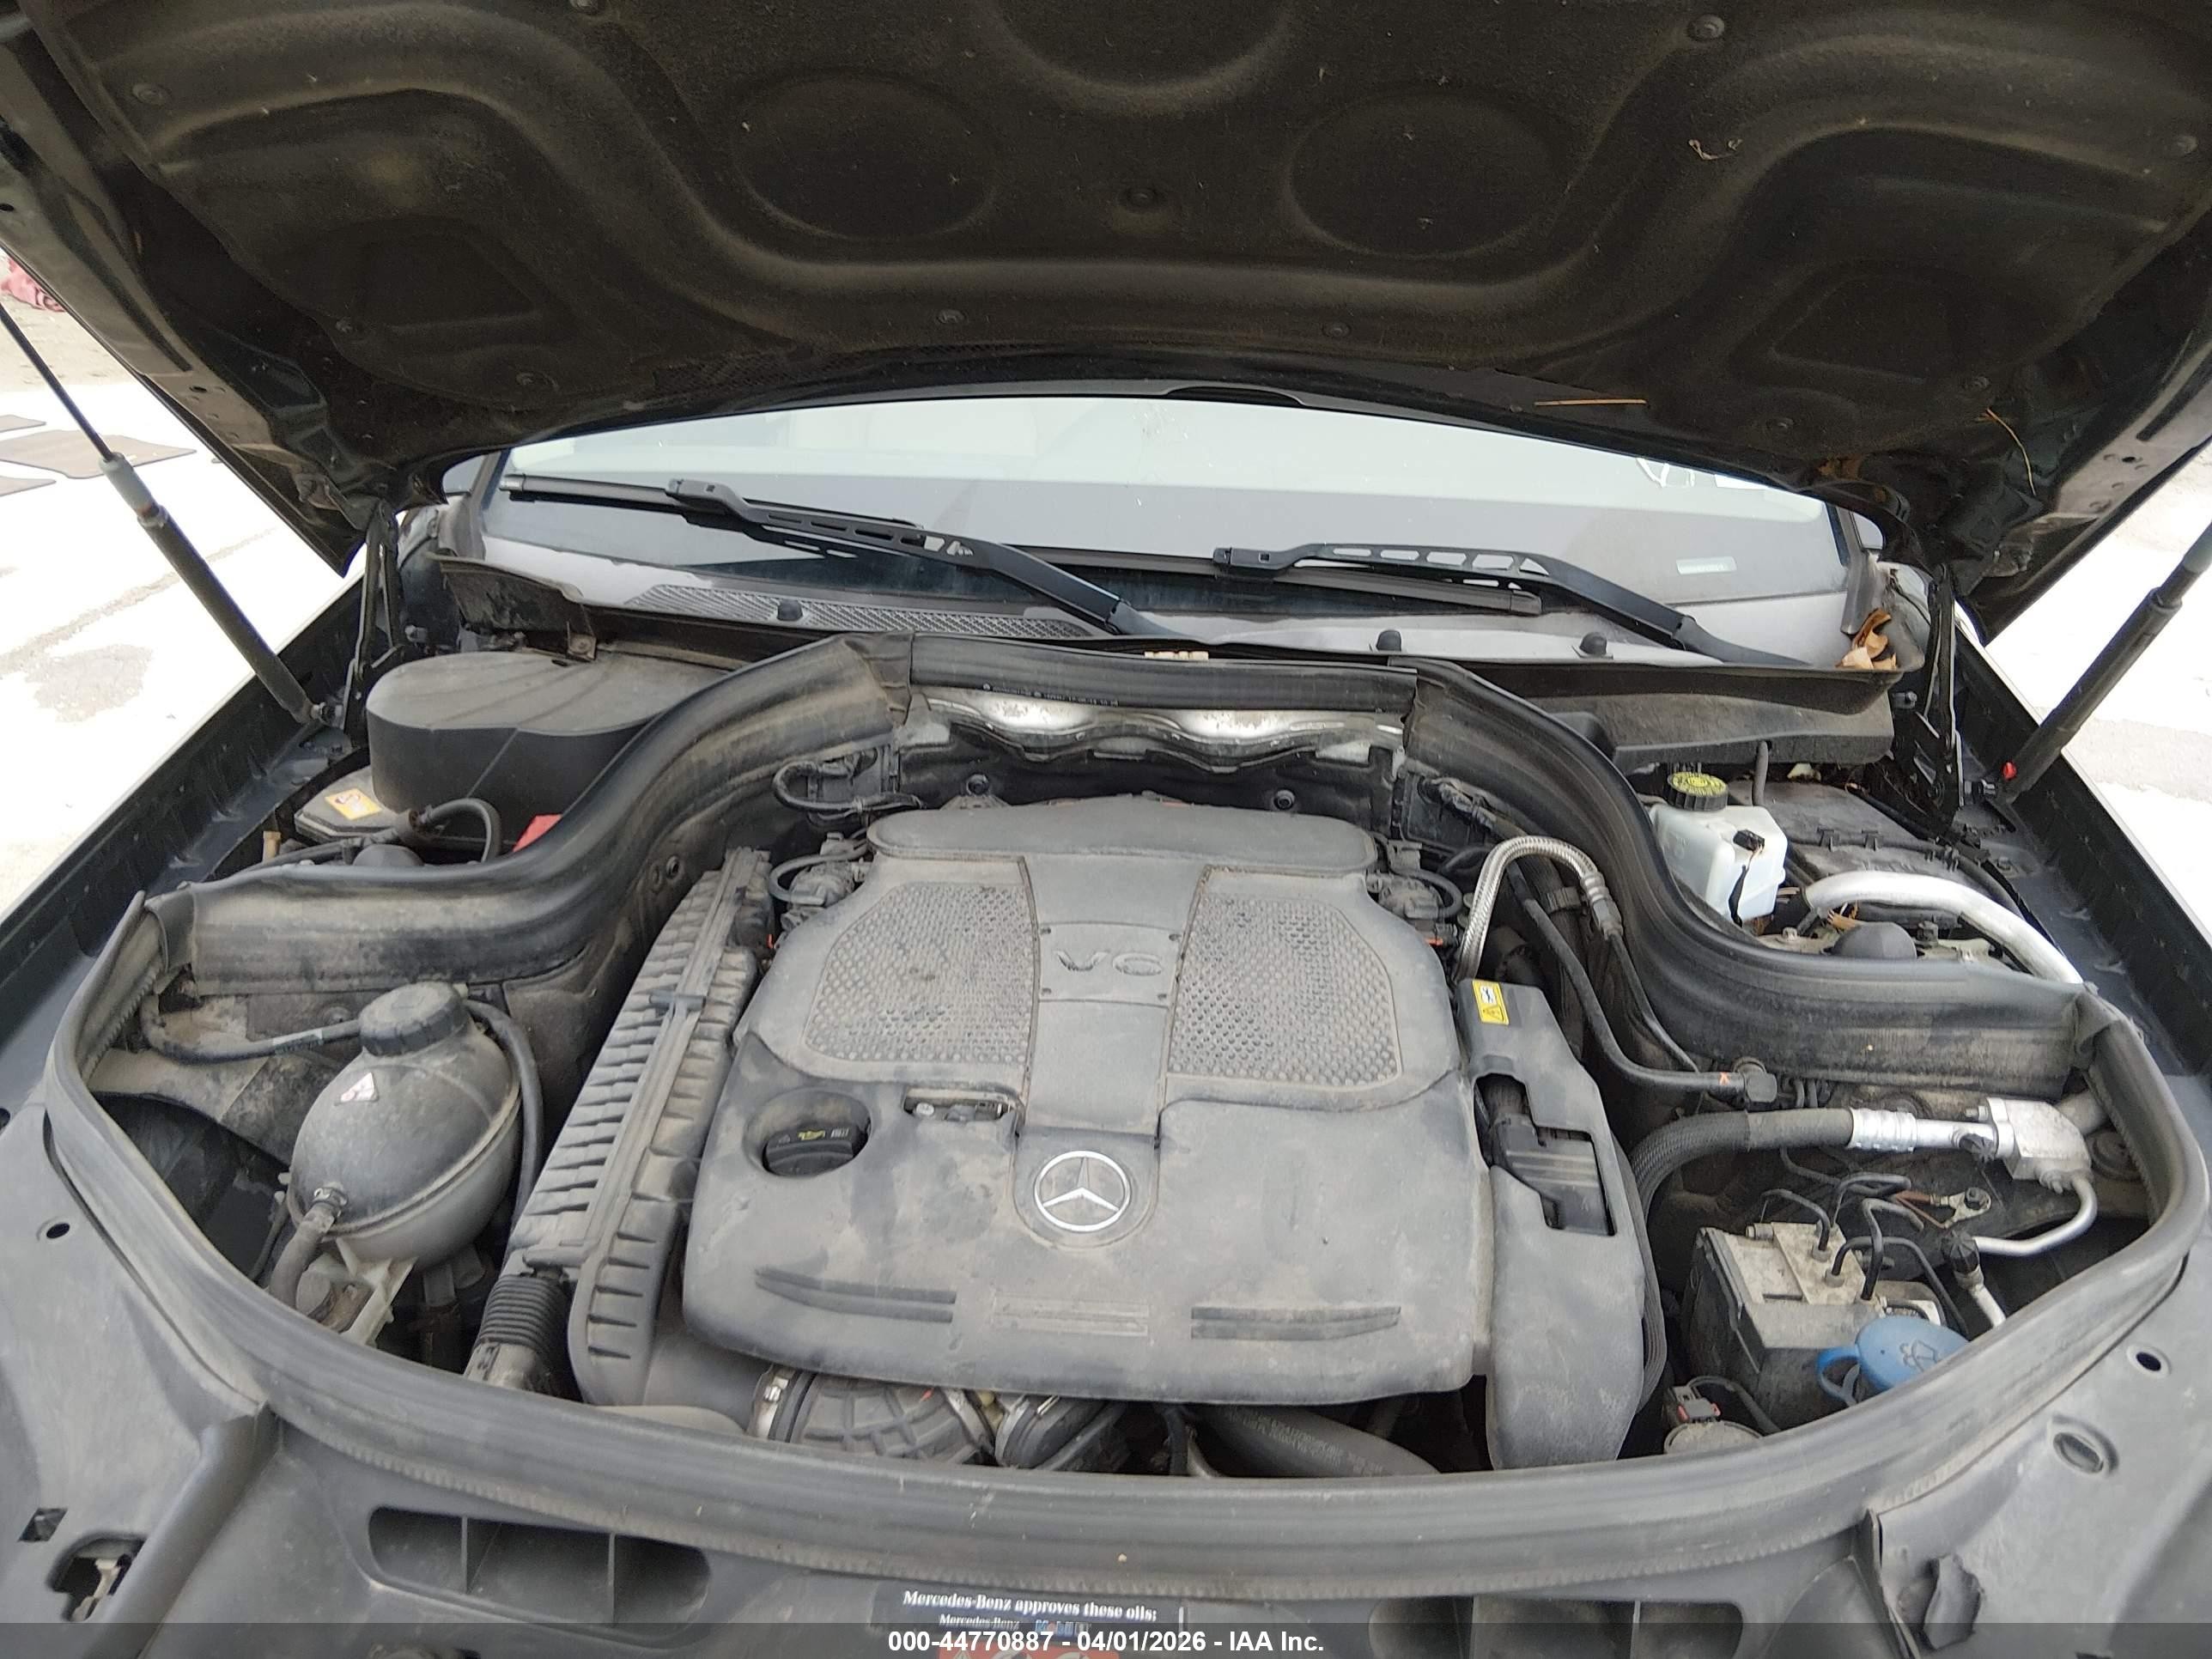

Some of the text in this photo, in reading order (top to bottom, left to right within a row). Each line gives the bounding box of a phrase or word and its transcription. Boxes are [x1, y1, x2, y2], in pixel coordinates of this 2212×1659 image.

[1053, 948, 1164, 977] V6
[902, 1590, 1158, 1622] Mercedes-Benz approves these oils:
[939, 1613, 1021, 1632] Mercedes-Benz
